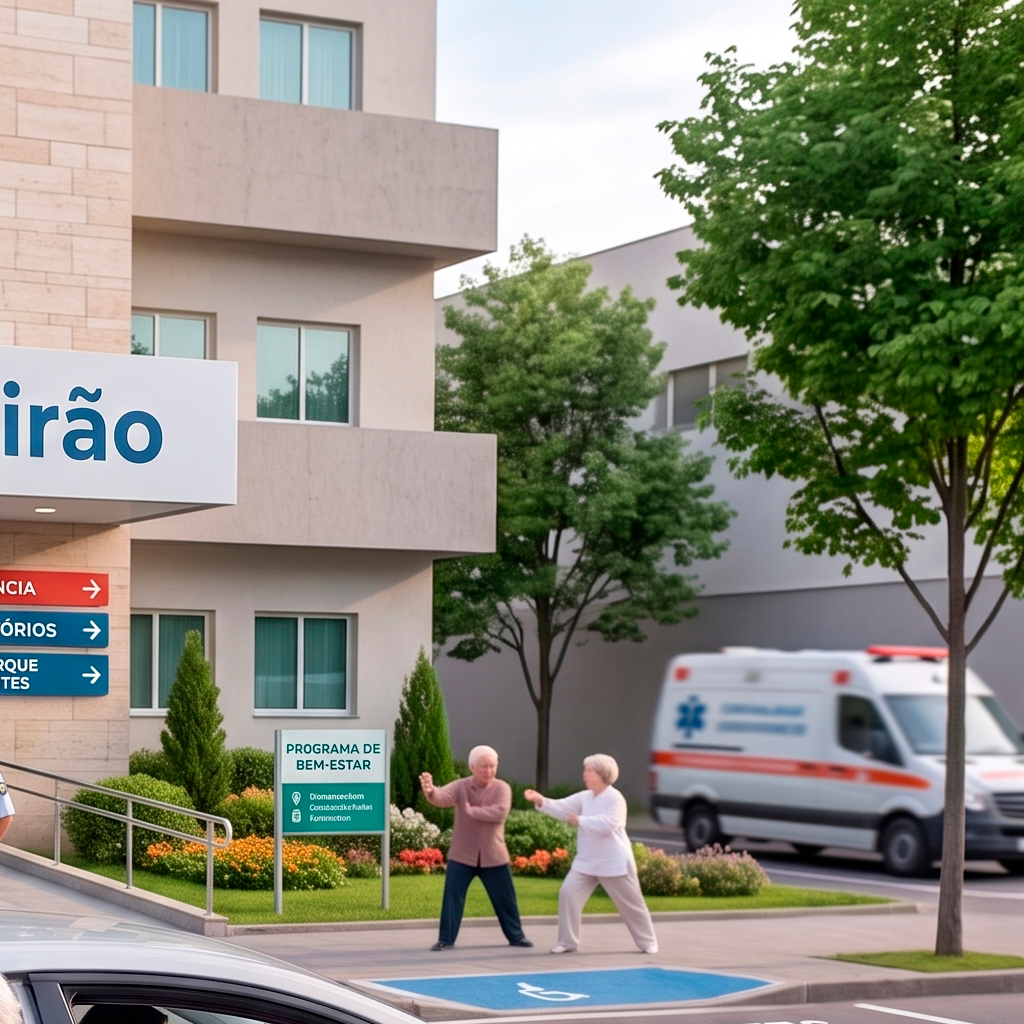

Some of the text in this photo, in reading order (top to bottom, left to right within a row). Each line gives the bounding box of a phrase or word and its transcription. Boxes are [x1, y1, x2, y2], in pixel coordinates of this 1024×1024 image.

[286, 743, 381, 755] PROGRAMA DE
[296, 759, 371, 771] BEM-ESTAR
